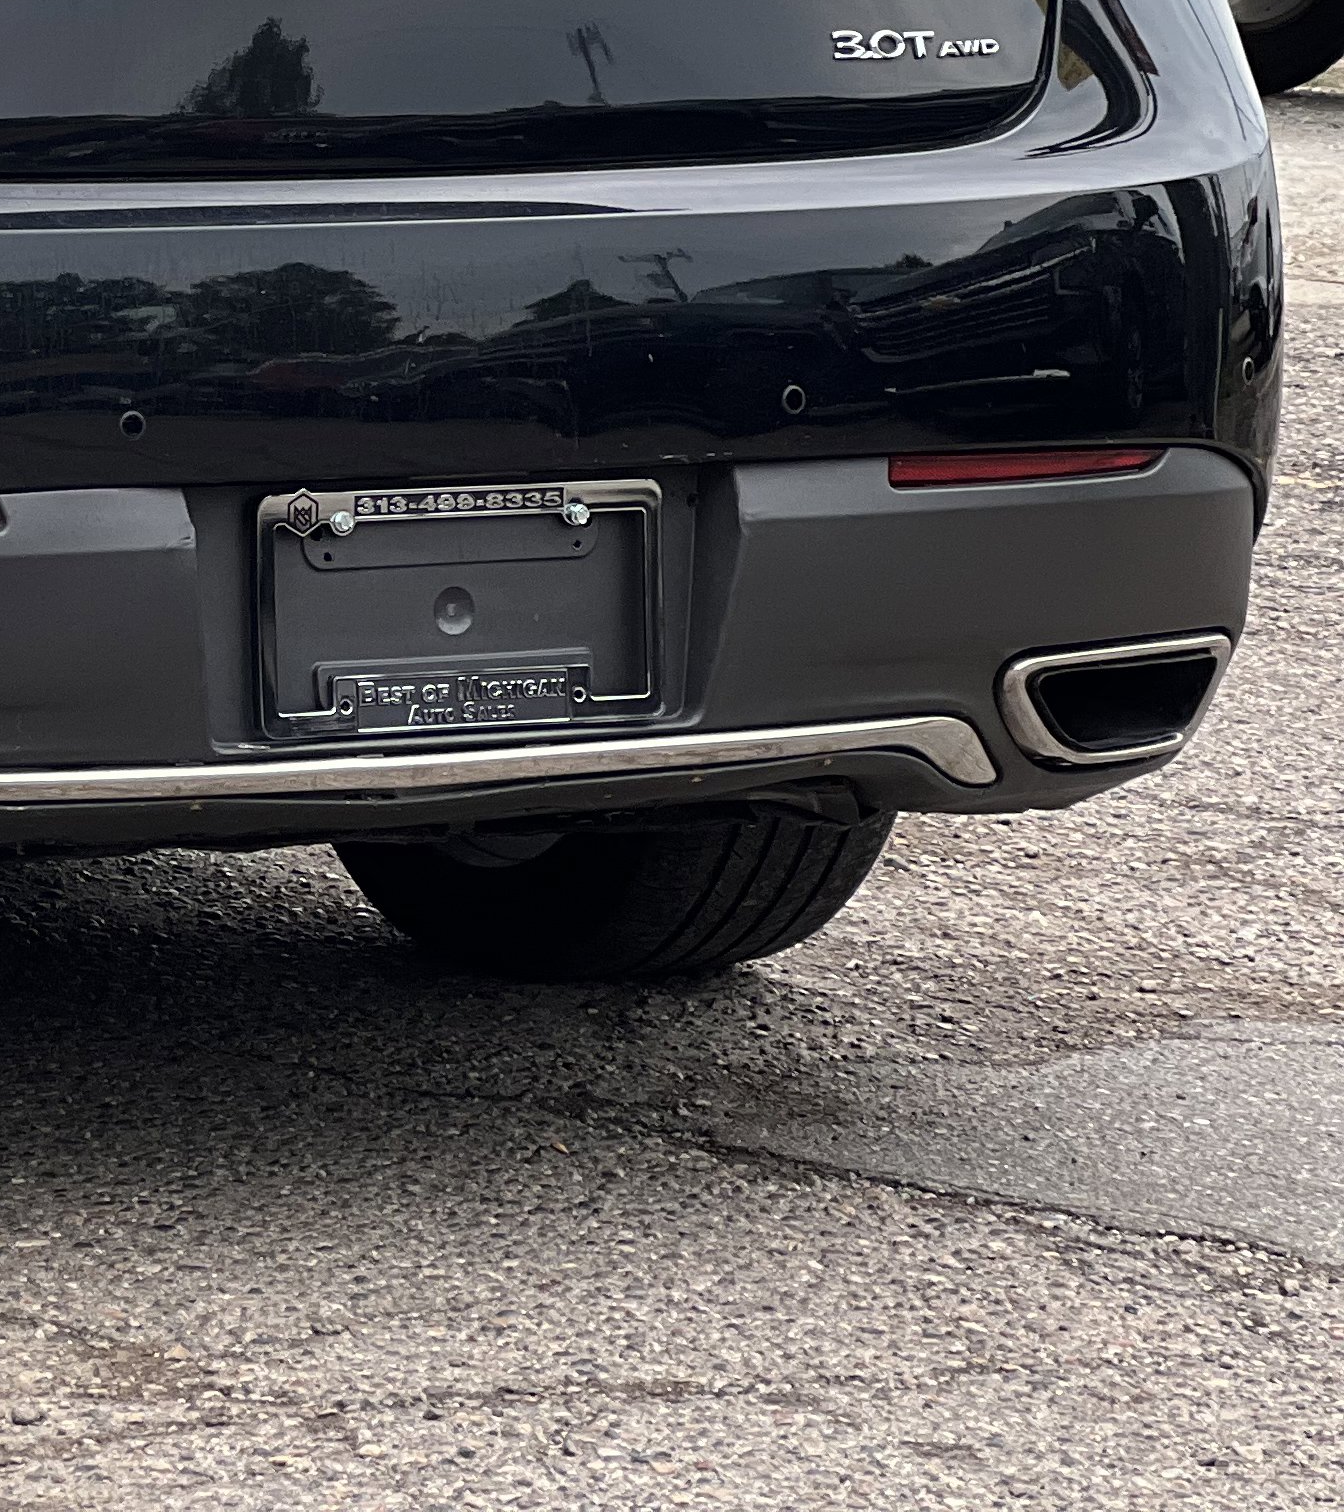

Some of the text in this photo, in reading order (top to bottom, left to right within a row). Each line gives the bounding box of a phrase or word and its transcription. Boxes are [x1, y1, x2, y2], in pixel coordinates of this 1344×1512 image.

[831, 29, 1000, 60] 3.0T AWD
[358, 675, 566, 706] BEST OF MICHIGAN
[408, 704, 455, 725] AUTO
